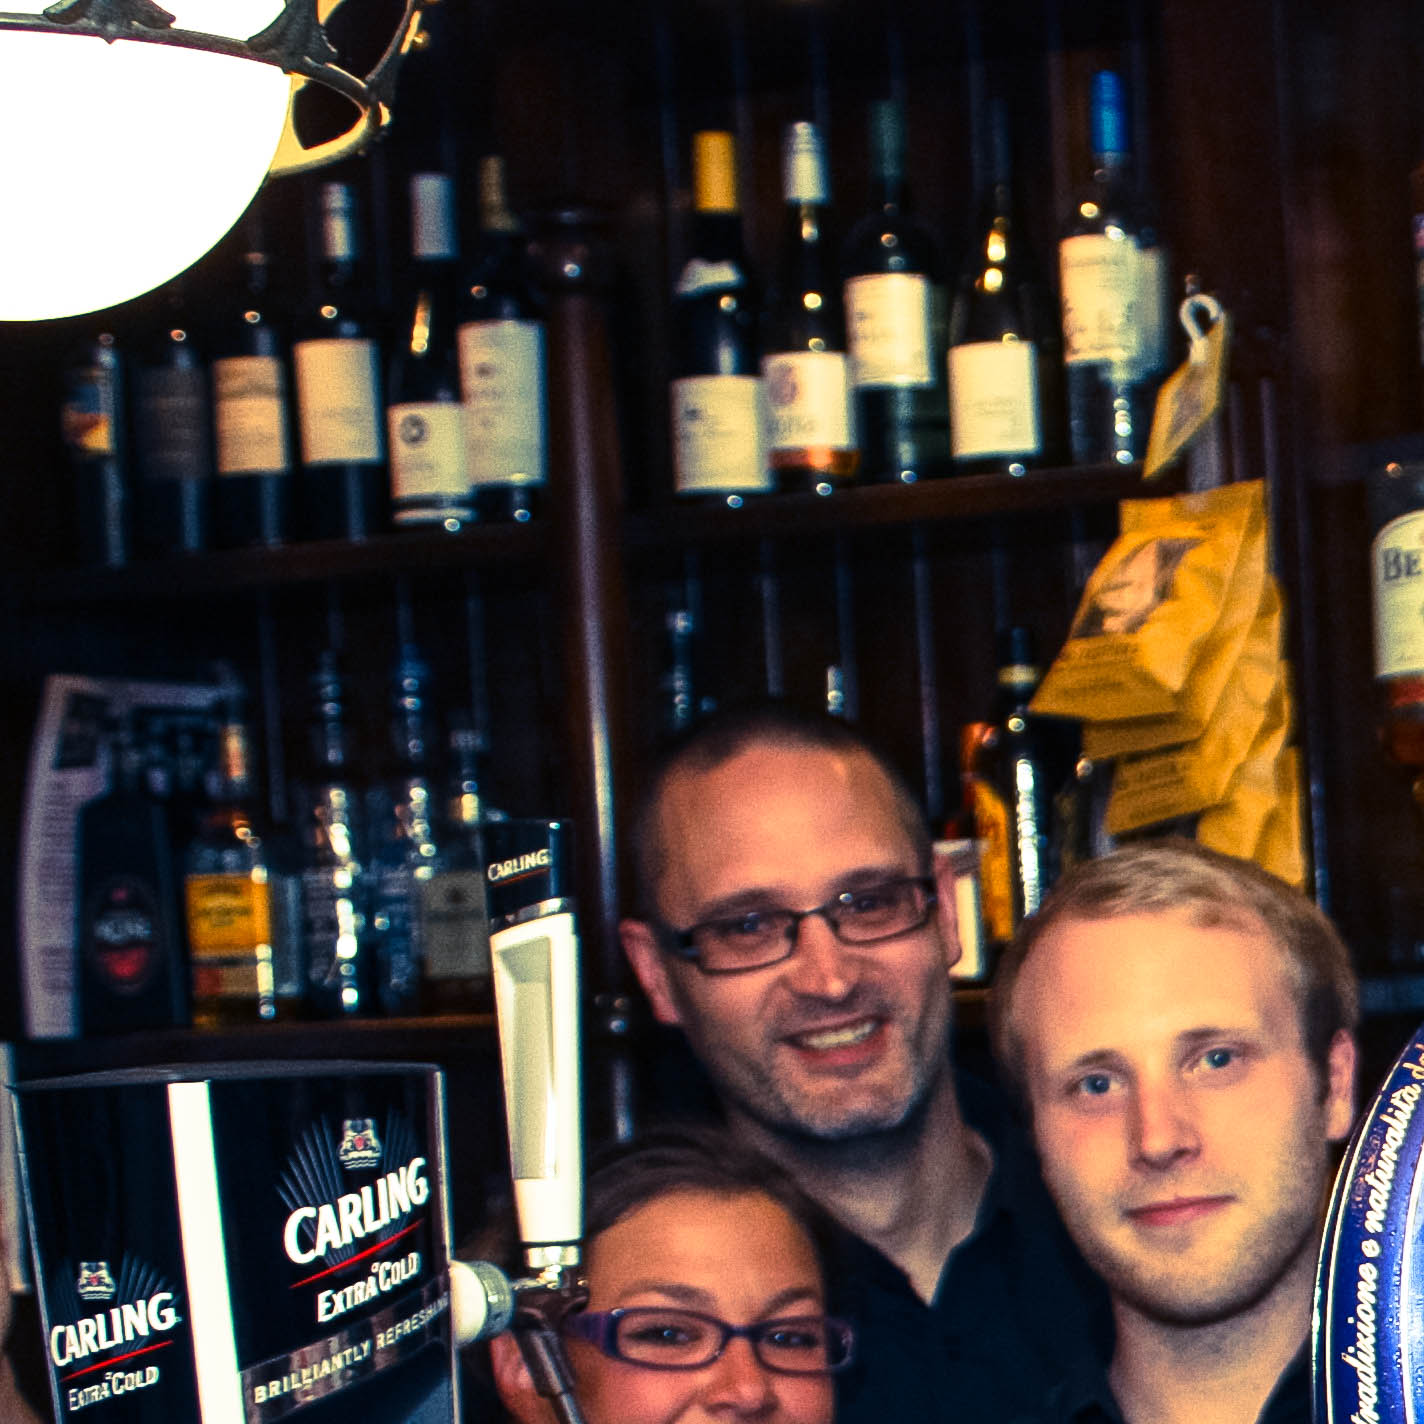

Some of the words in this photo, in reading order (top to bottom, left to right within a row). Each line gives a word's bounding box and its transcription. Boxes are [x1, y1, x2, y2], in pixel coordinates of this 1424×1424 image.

[487, 848, 552, 881] CARLING
[284, 1157, 430, 1264] CARLING
[1361, 1239, 1380, 1259] e
[317, 1275, 380, 1323] EXTRA
[51, 1292, 177, 1367] CARLING
[254, 1339, 373, 1404] BRILLIANTLY
